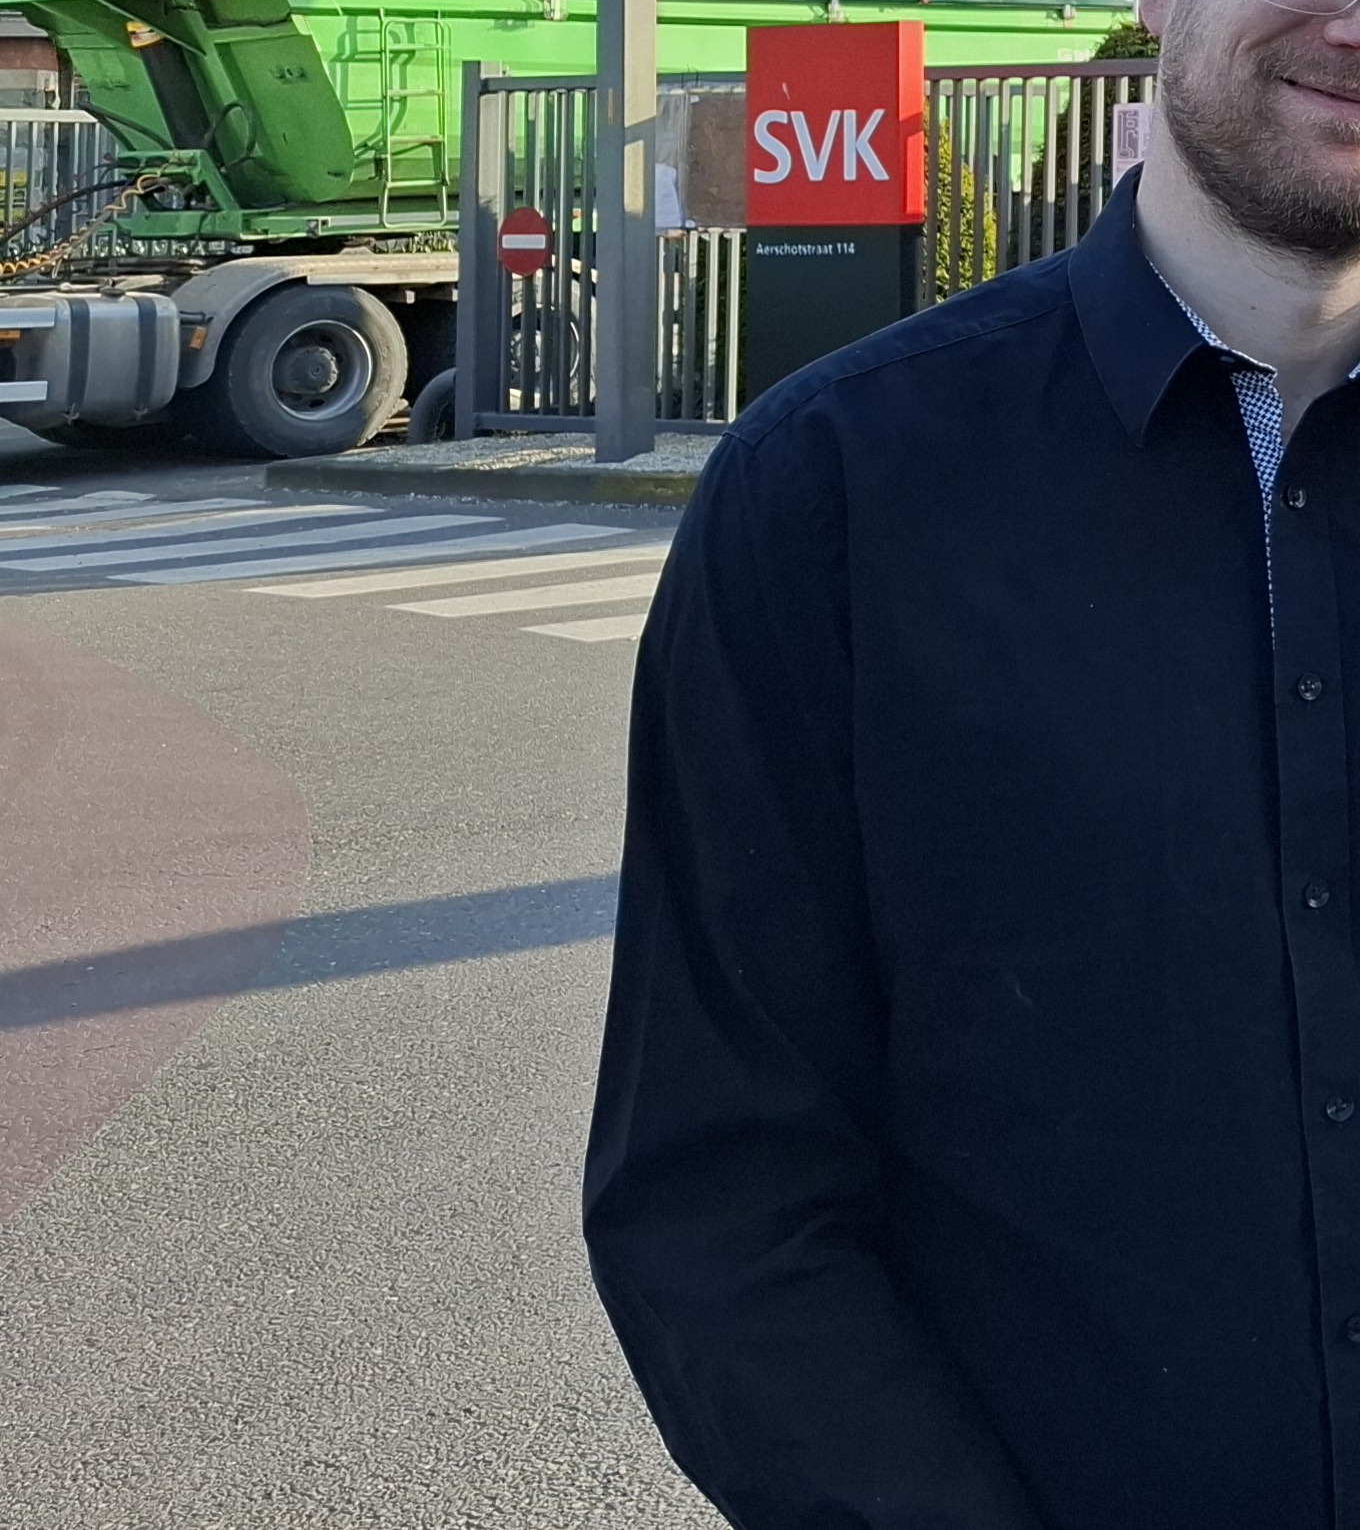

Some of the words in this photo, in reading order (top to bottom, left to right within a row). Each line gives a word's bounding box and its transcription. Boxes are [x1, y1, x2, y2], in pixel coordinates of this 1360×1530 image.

[754, 108, 890, 184] SVK
[756, 242, 833, 255] Aerschotstraat
[836, 242, 855, 255] 114
